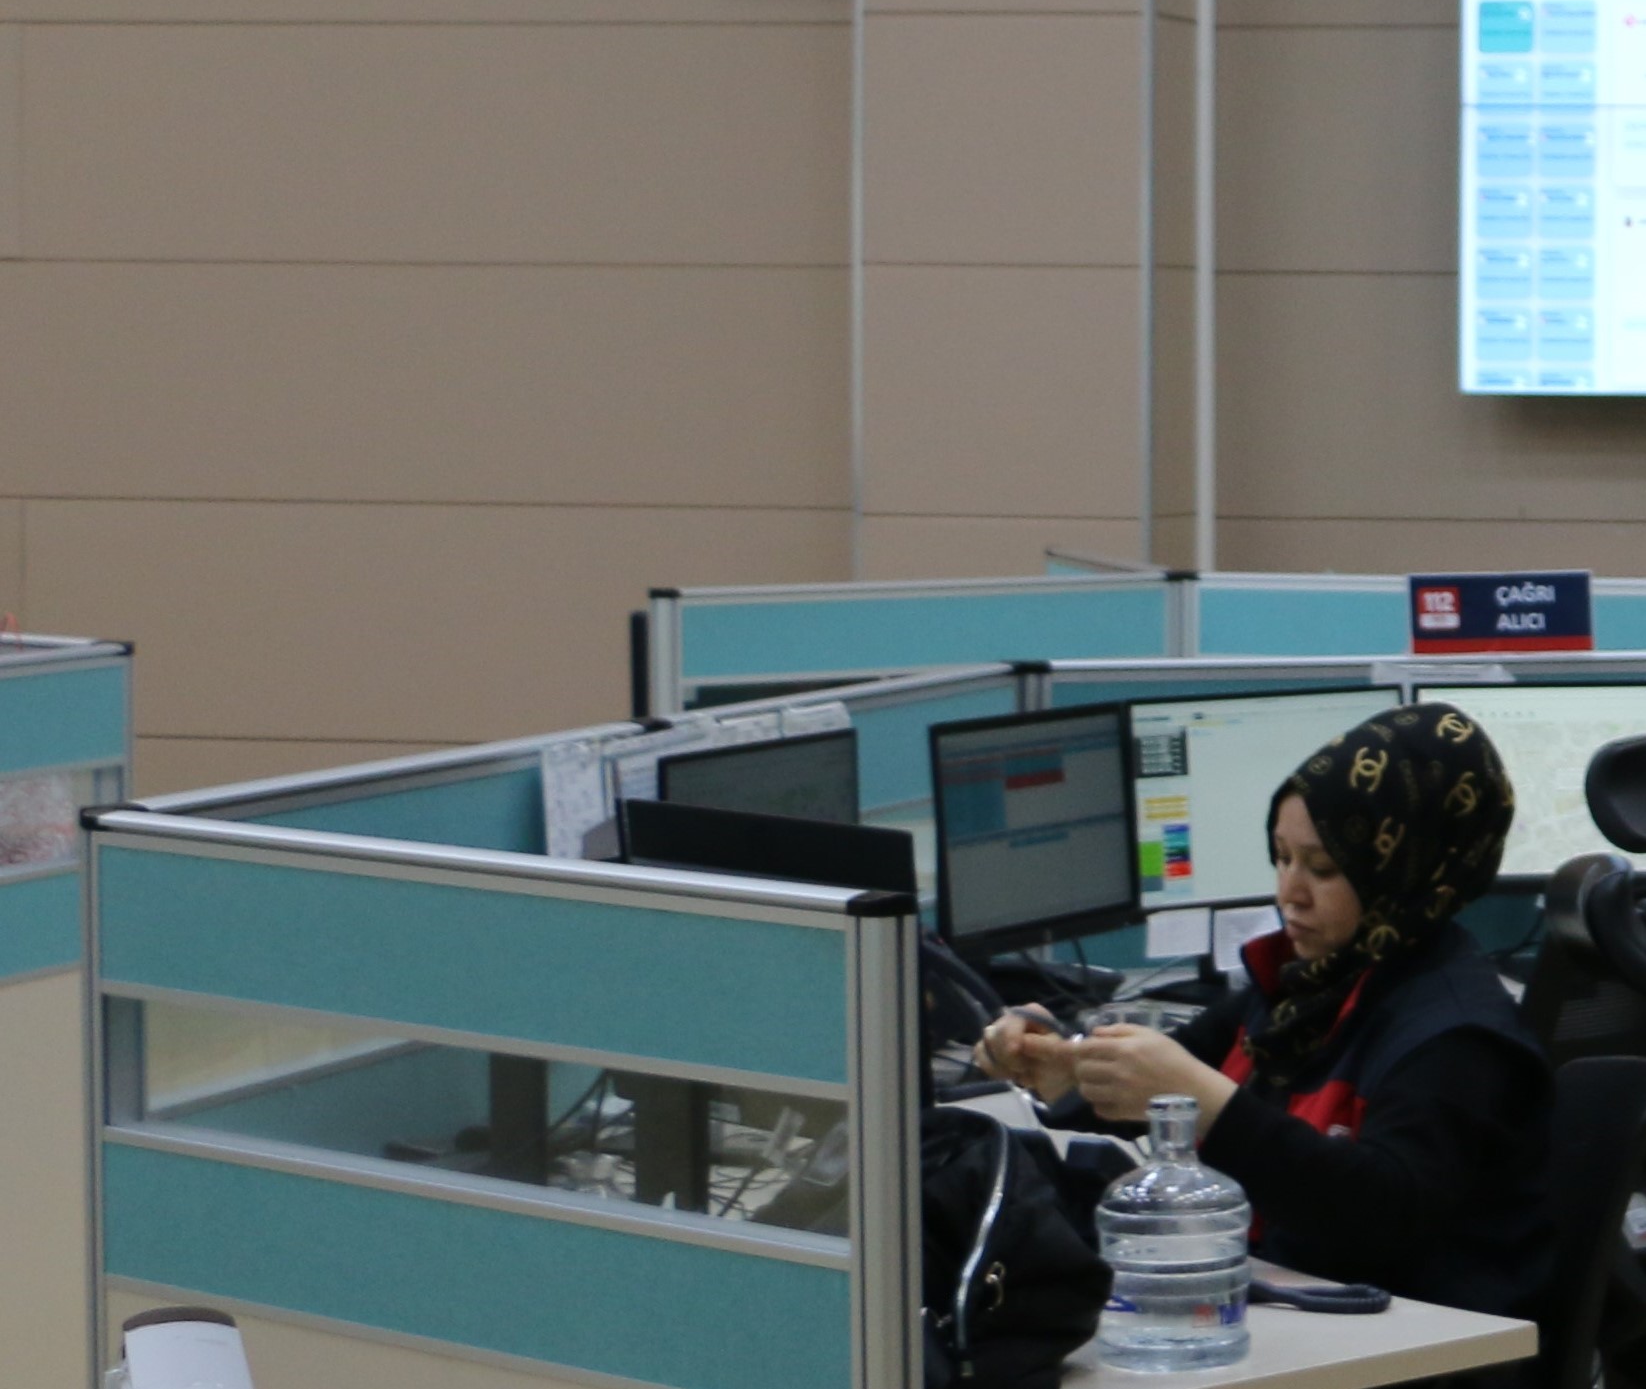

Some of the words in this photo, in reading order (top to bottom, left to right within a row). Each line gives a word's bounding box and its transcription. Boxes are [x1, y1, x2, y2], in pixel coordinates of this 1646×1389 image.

[1423, 591, 1456, 612] 112
[1494, 581, 1556, 607] ÇAĞRI
[1496, 612, 1547, 630] ALICI
